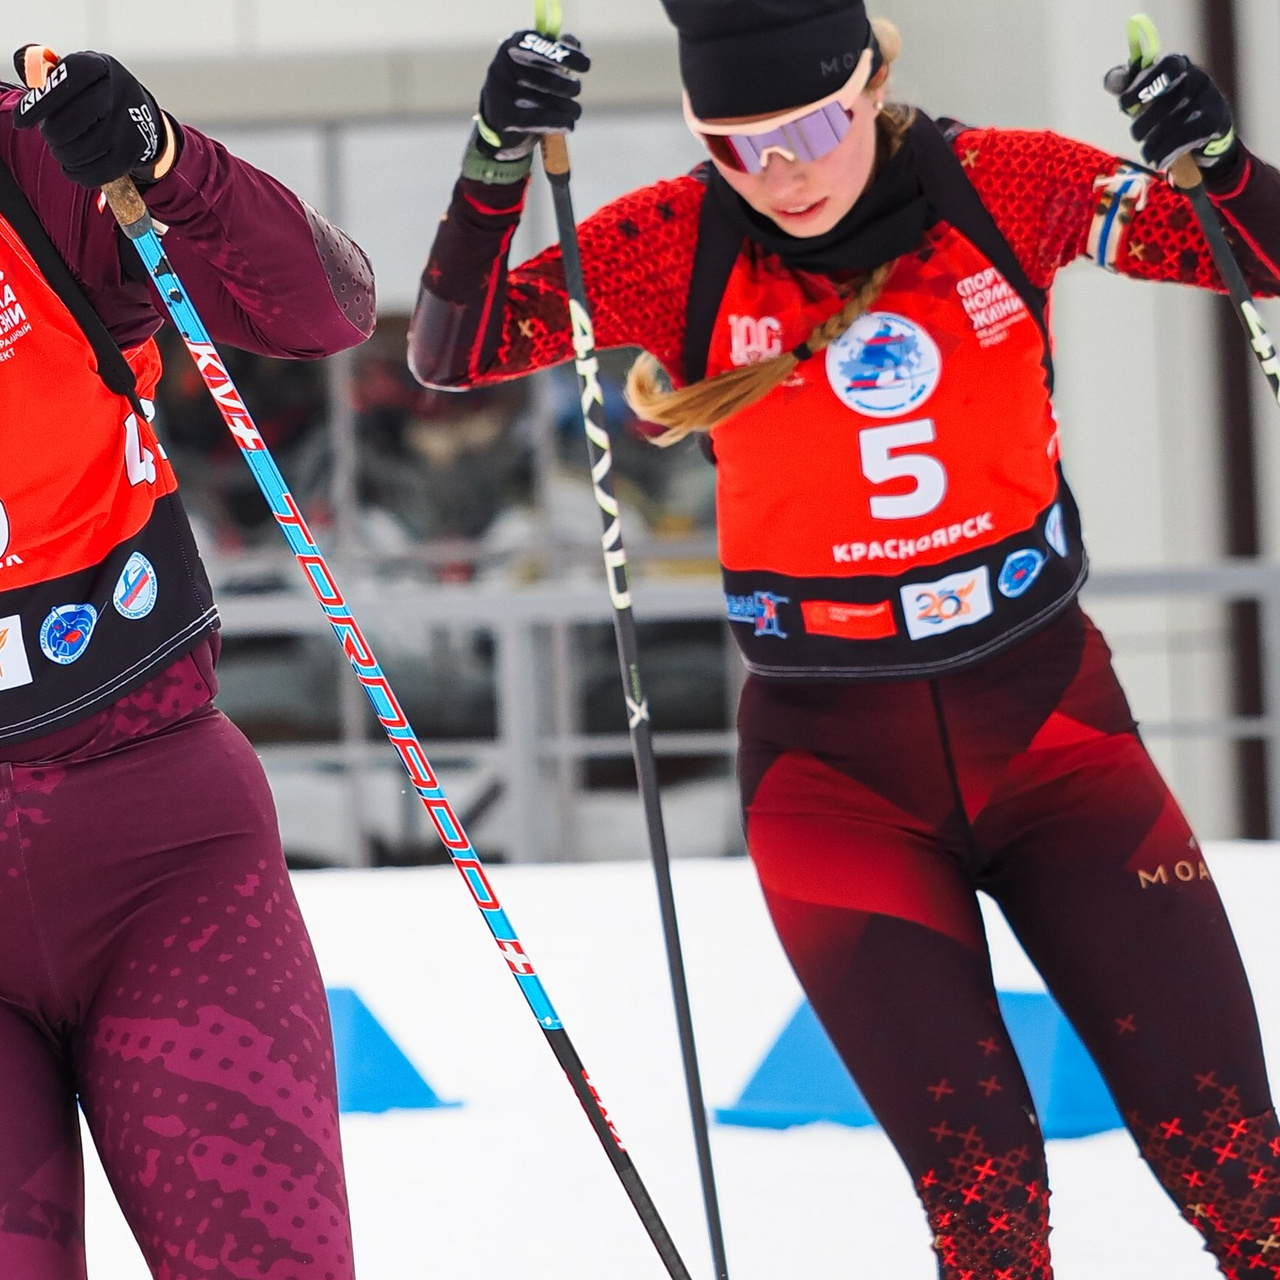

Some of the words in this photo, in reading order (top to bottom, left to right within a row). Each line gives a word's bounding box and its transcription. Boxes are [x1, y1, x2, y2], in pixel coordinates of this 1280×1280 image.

[858, 418, 948, 520] 5
[832, 512, 994, 563] КРАСНОЯРСК
[273, 491, 503, 913] TORNADO
